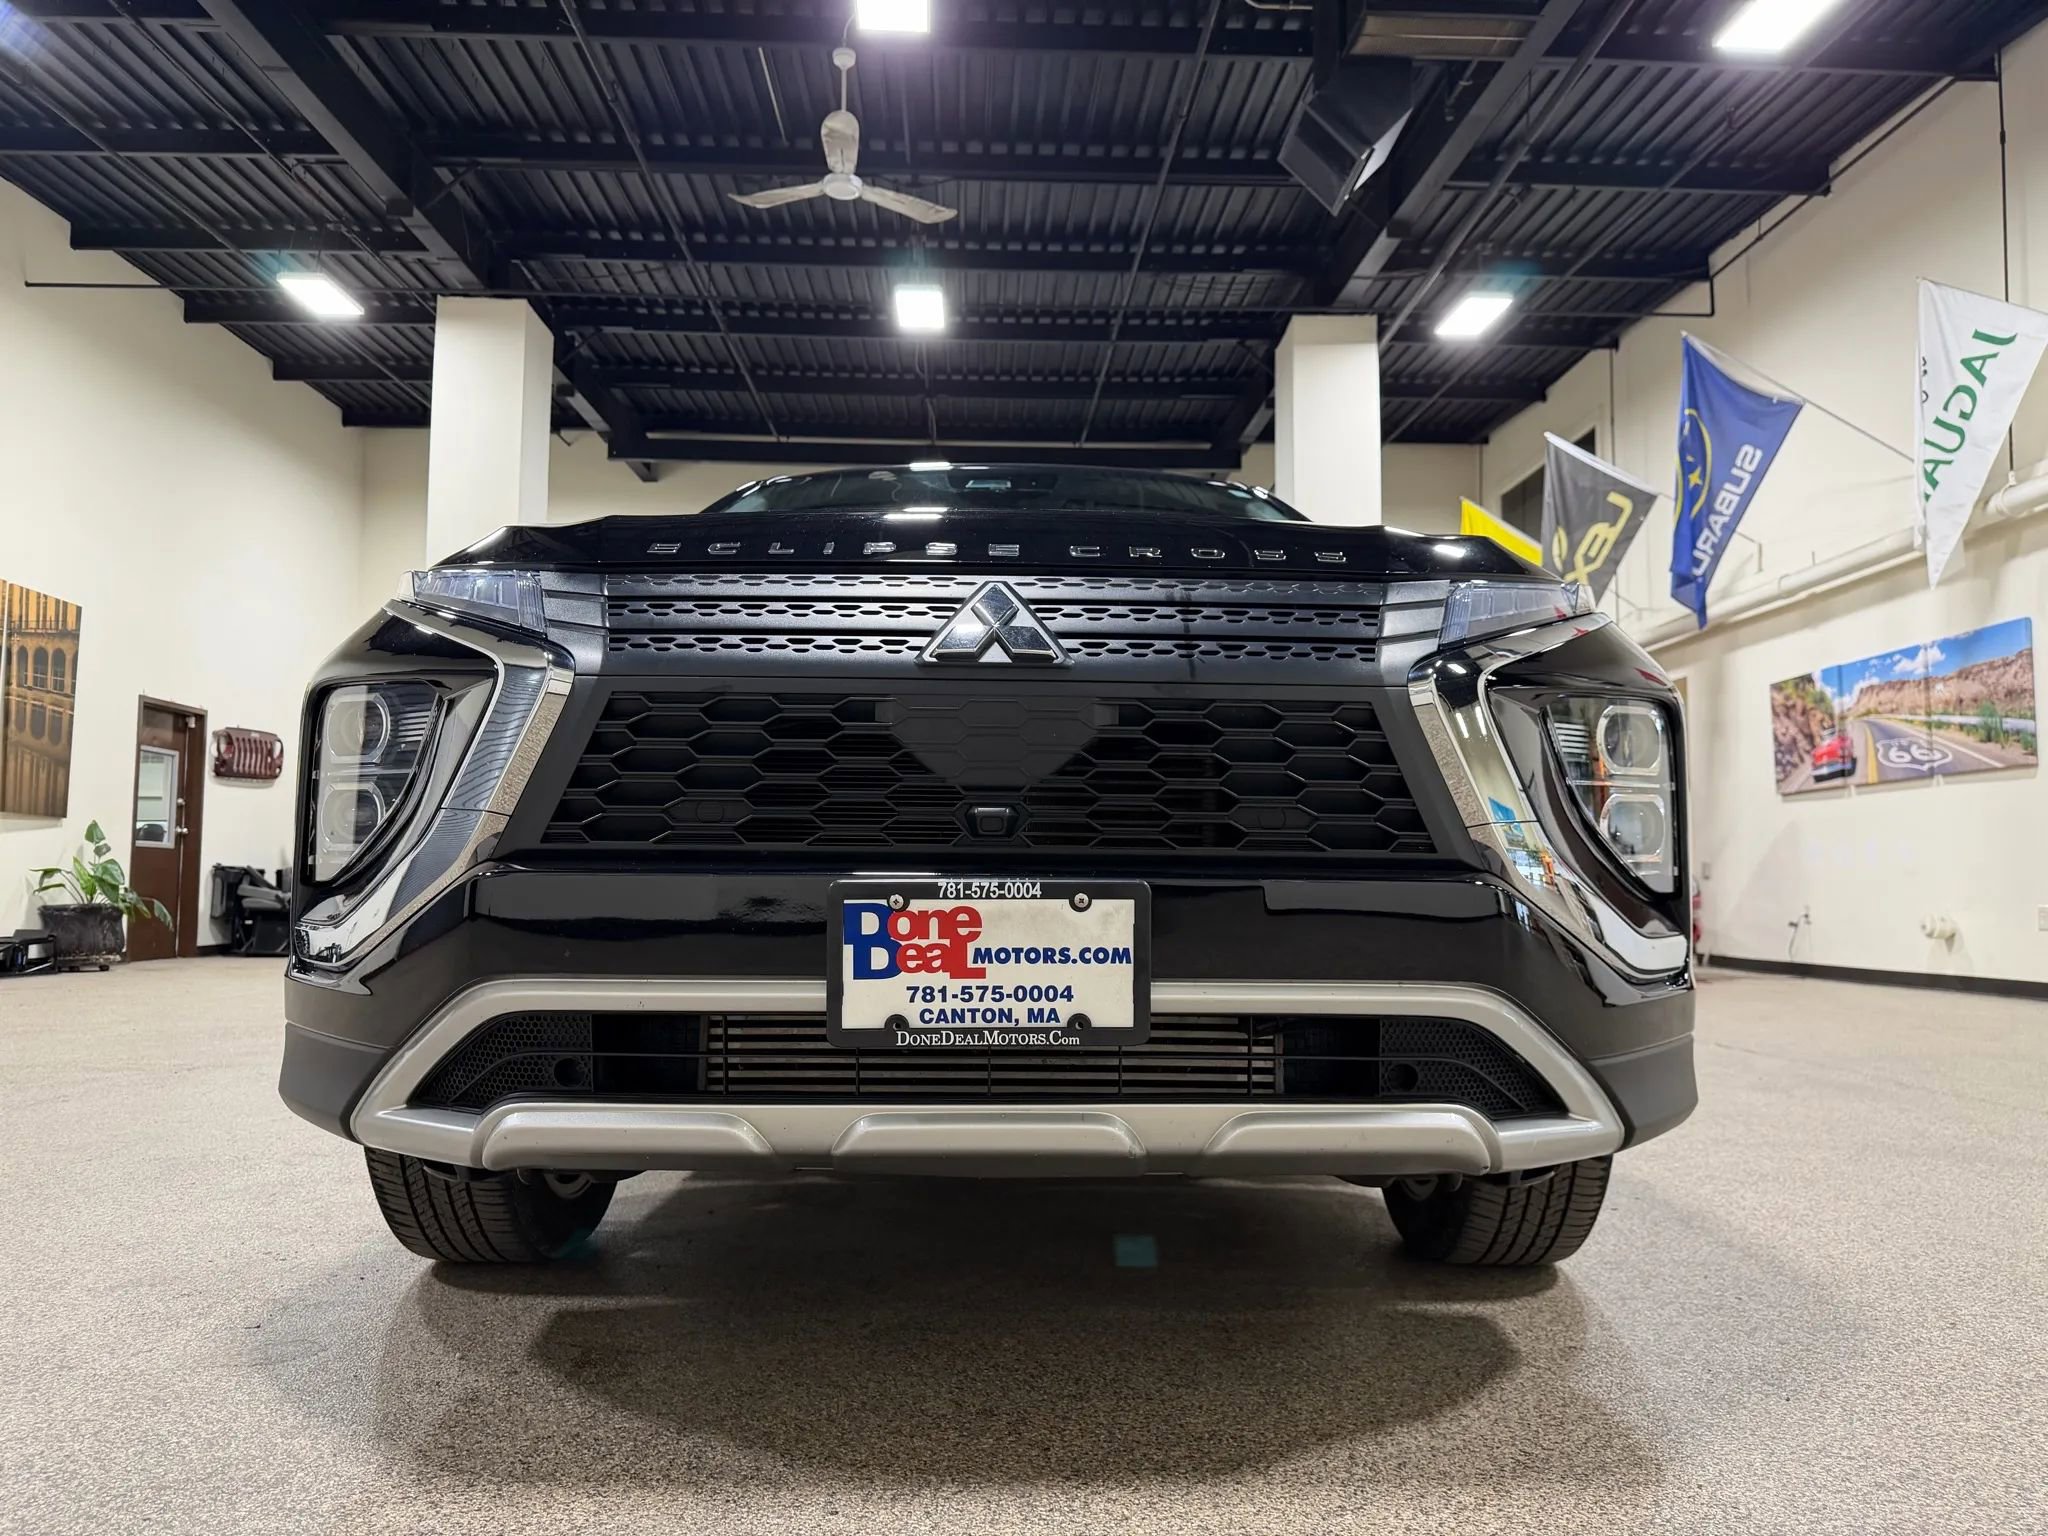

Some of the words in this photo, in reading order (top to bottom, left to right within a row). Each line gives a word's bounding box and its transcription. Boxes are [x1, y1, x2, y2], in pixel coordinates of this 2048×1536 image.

[646, 541, 1020, 557] ECLIPSE
[1069, 545, 1347, 562] CROSS
[1888, 743, 1943, 763] 66
[937, 881, 1042, 899] 781-575-0004
[843, 902, 983, 945] Done
[972, 946, 1132, 965] MOTORS.COM
[906, 985, 1074, 1003] 781-575-0004
[919, 1007, 1020, 1027] CANTON,
[1027, 1007, 1061, 1024] MA
